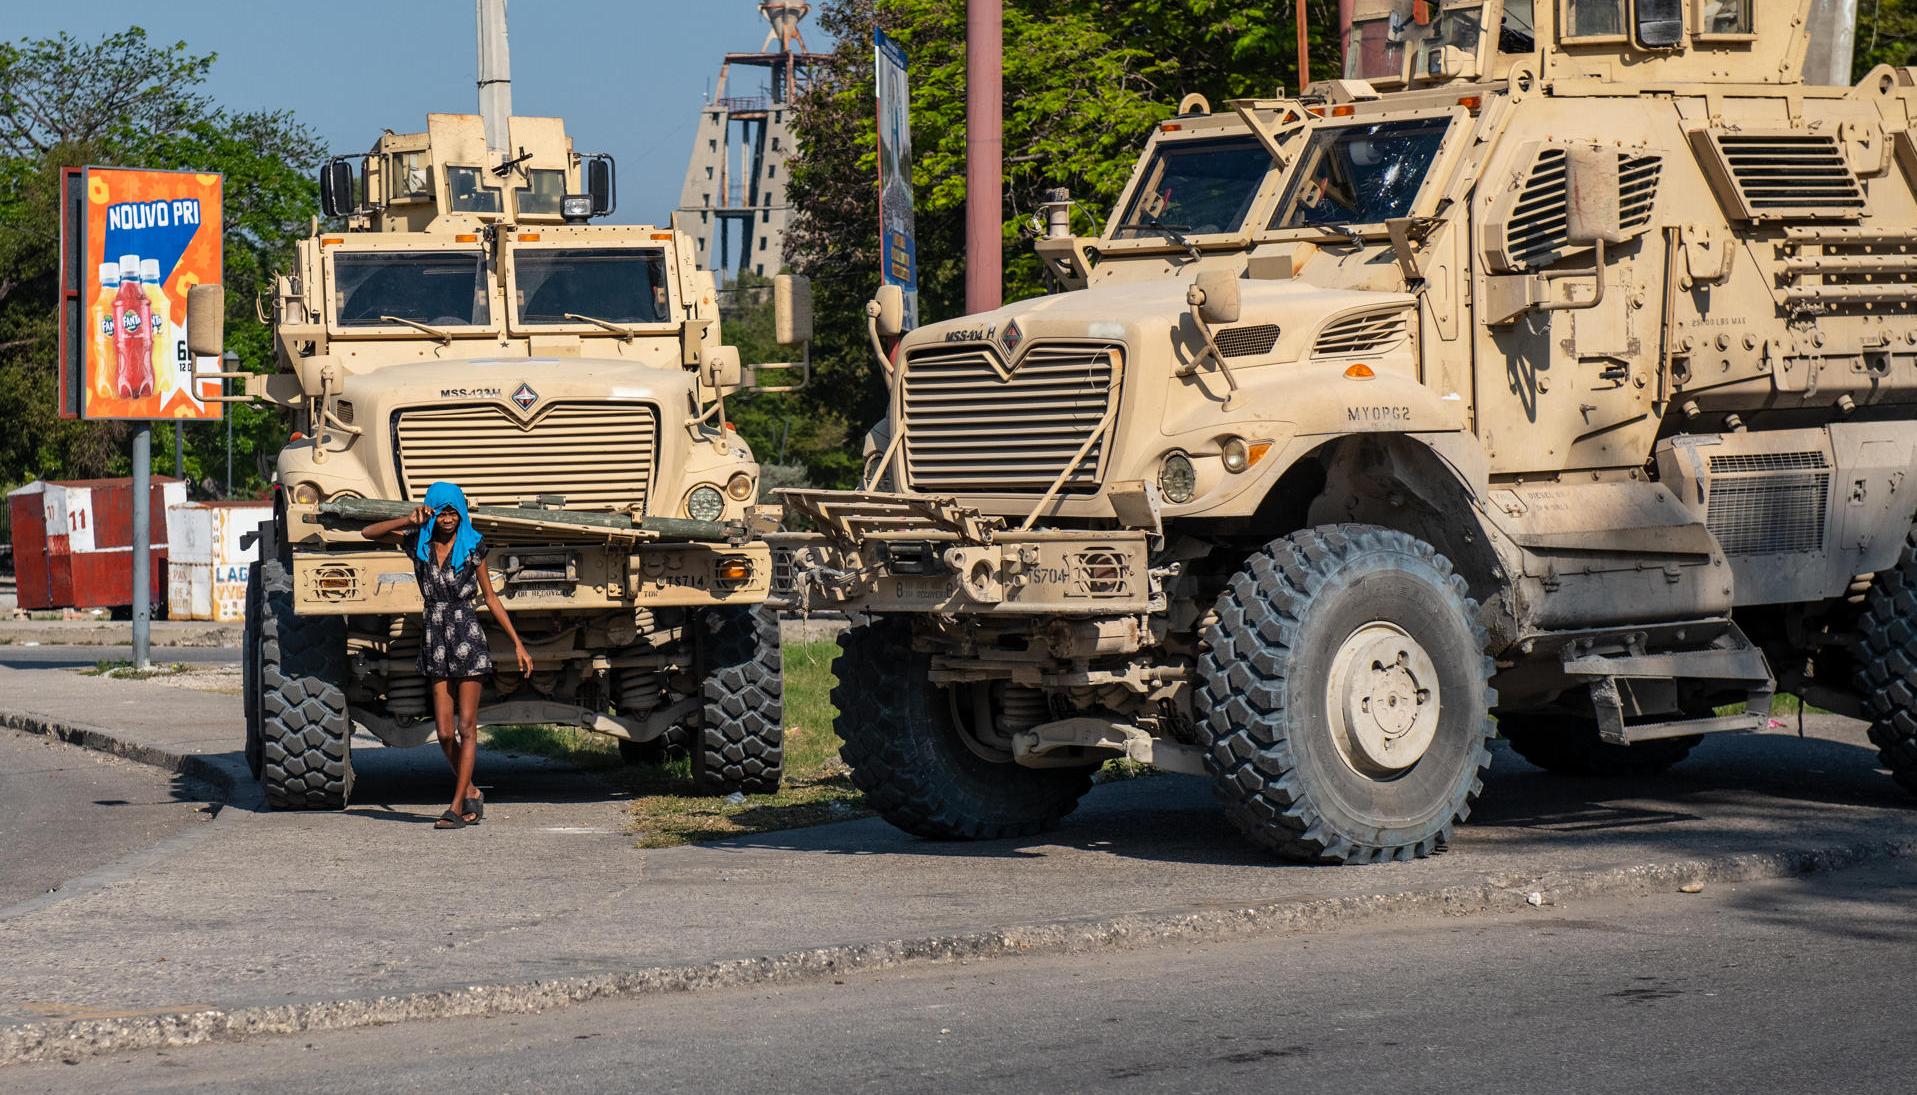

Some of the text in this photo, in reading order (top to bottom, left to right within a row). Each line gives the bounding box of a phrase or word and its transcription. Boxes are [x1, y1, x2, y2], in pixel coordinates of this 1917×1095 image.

[109, 201, 198, 230] NOUVO PRI
[69, 508, 86, 531] 11
